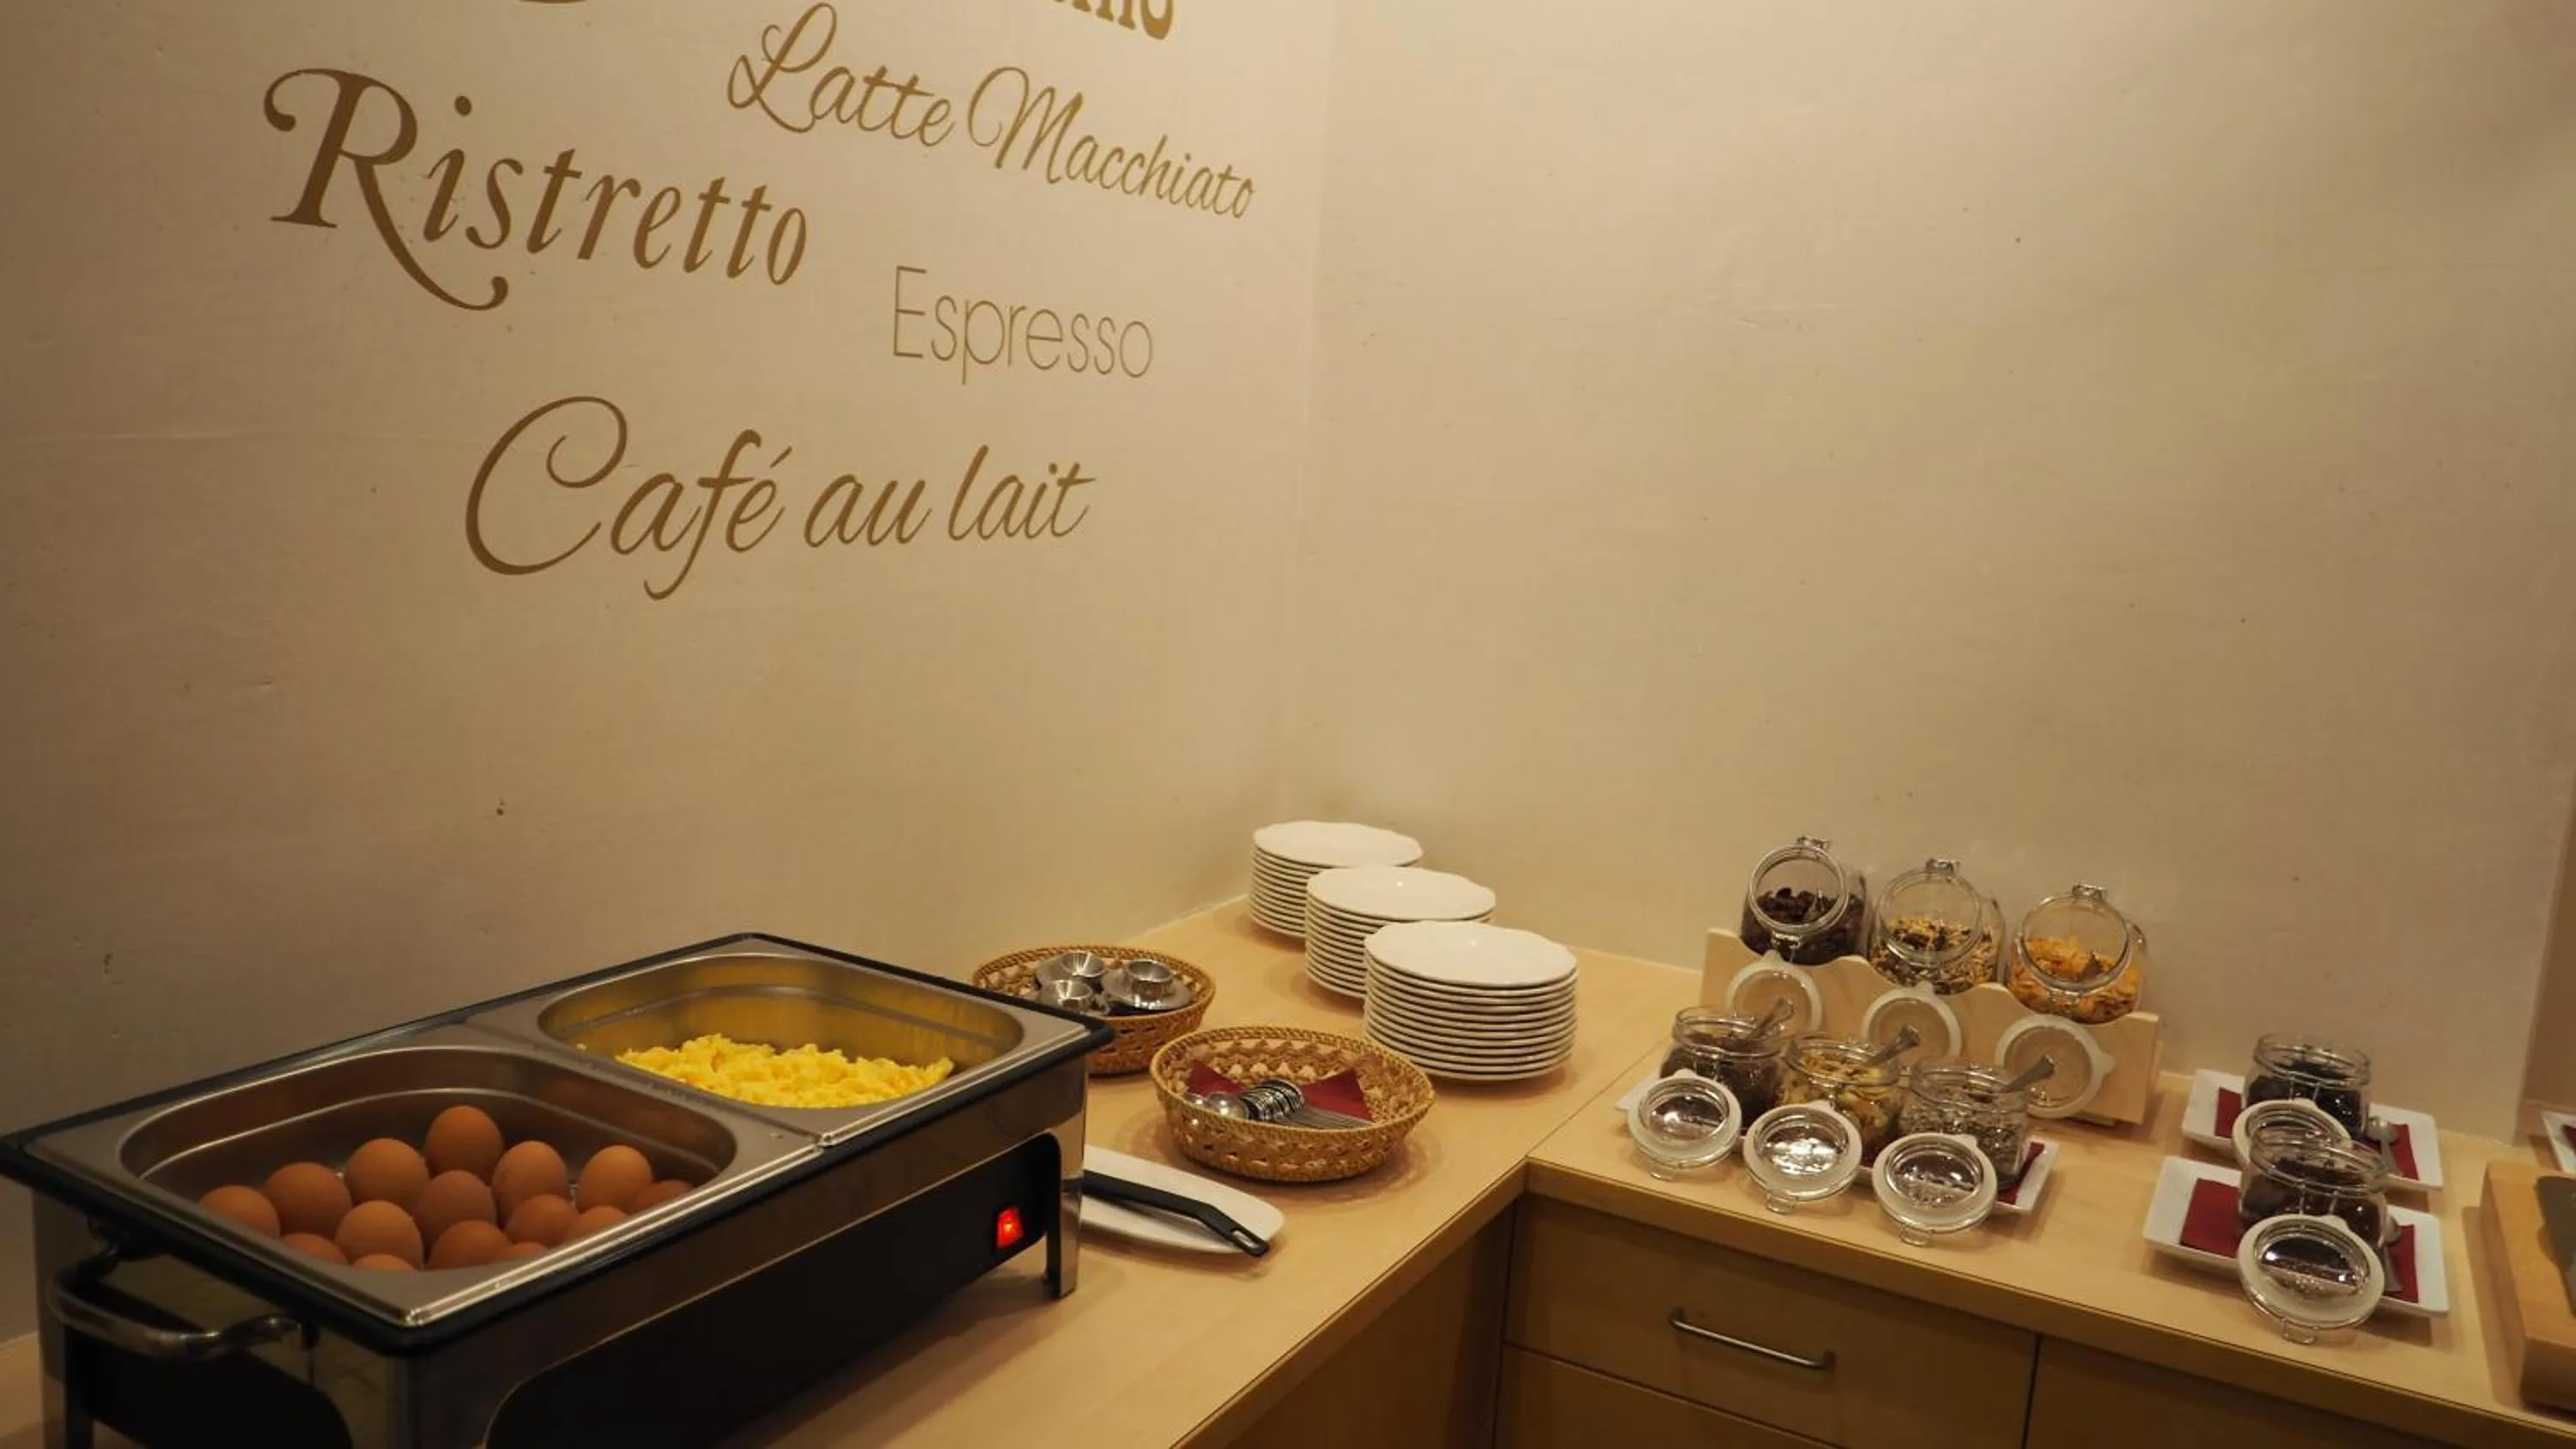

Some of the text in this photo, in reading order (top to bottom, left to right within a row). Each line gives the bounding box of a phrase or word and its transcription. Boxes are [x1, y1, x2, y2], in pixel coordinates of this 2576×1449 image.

[263, 67, 809, 312] Ristretto
[726, 2, 1257, 221] Latte Macchiato
[891, 265, 1154, 385] Espresso
[465, 395, 1098, 602] Café au lait
